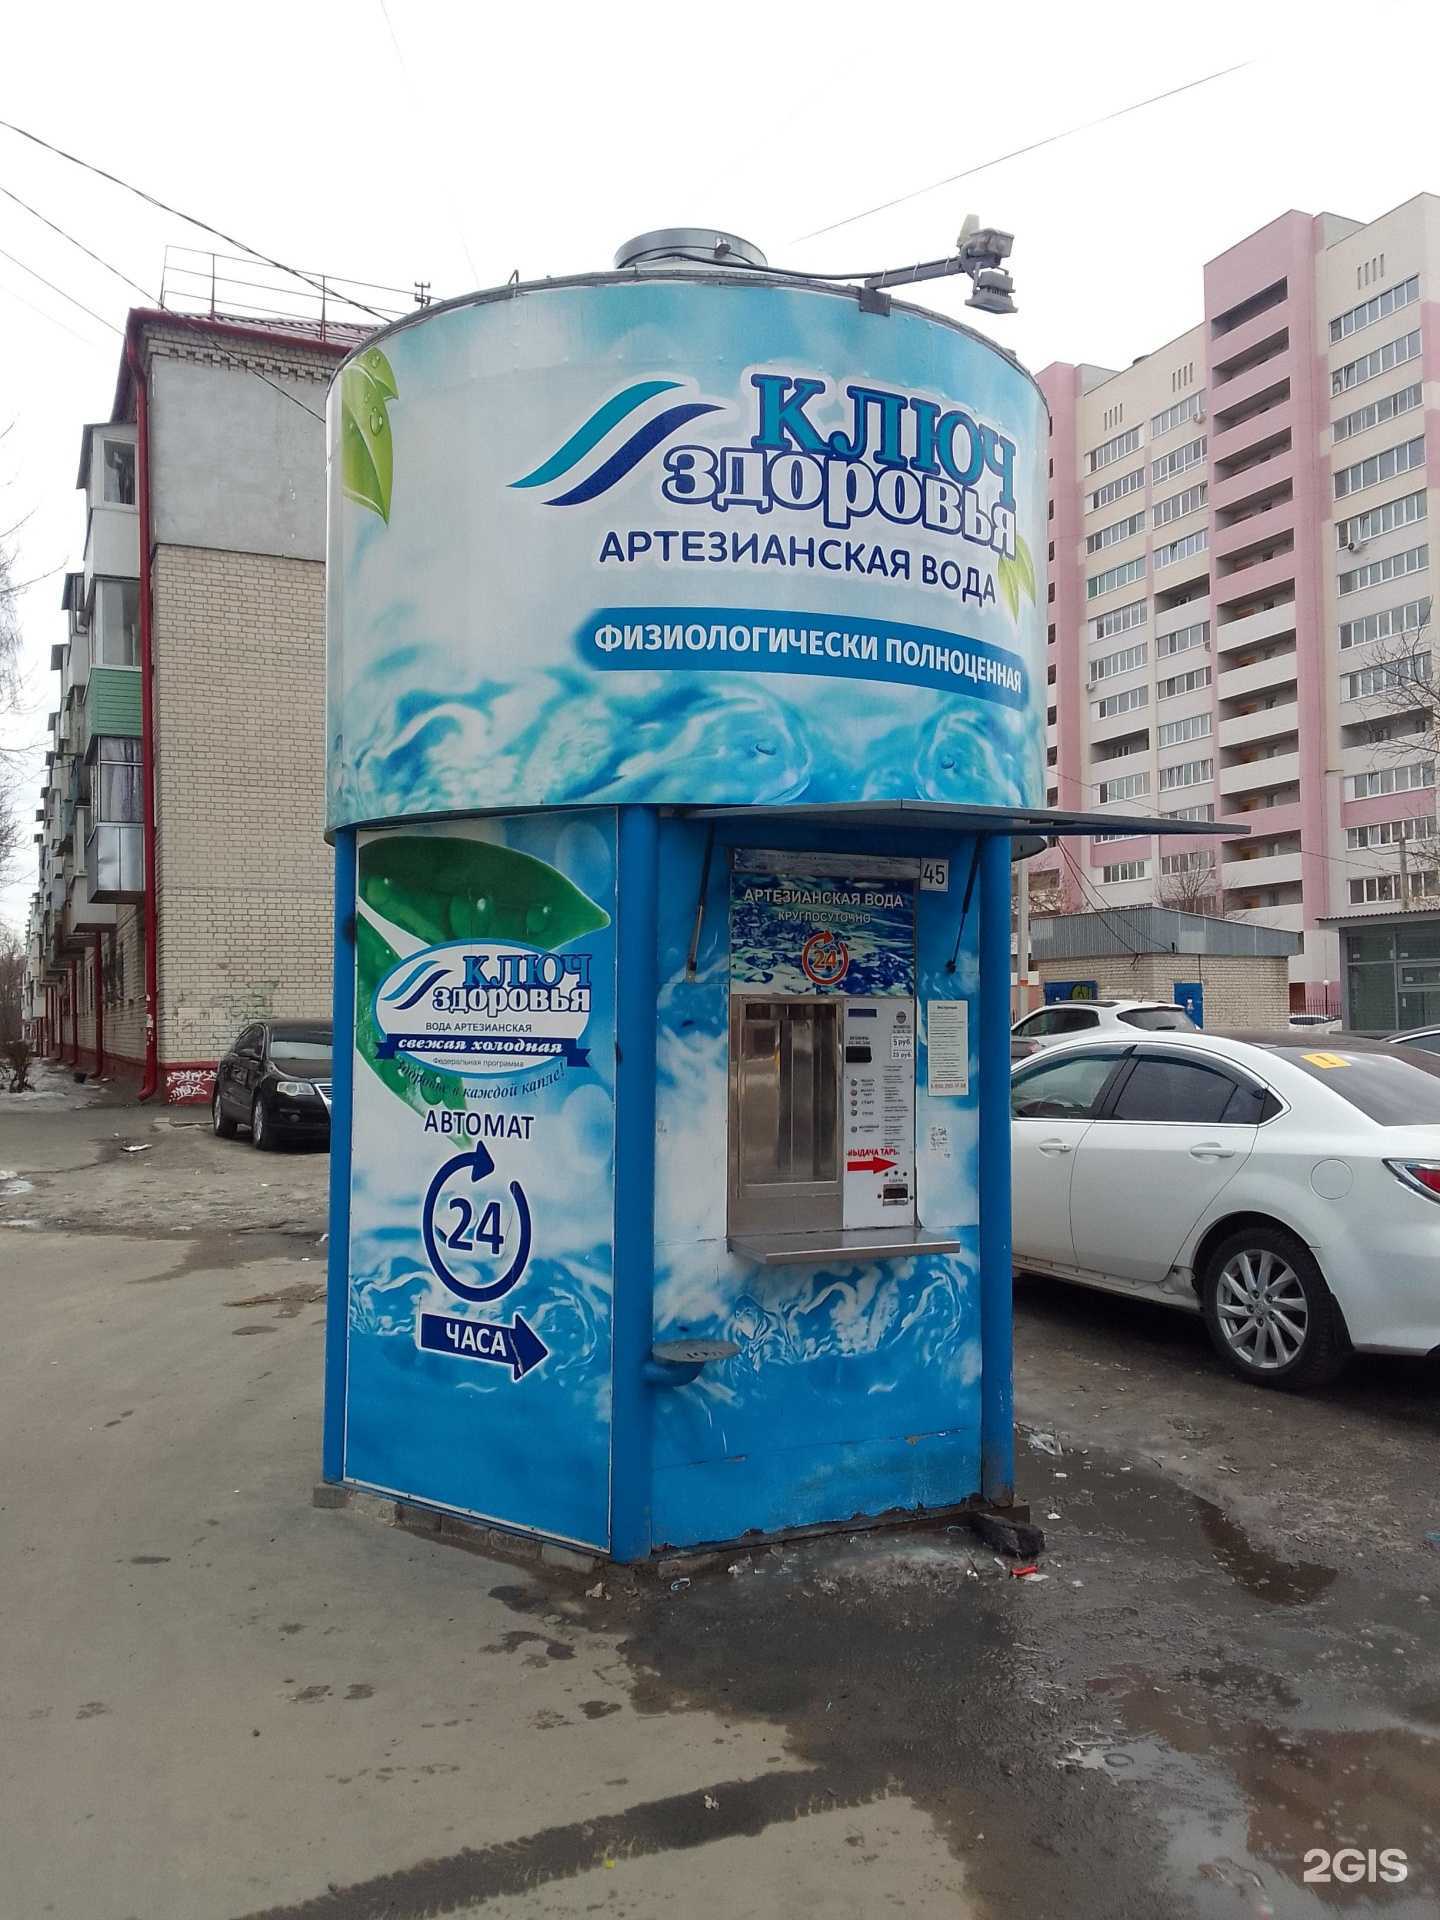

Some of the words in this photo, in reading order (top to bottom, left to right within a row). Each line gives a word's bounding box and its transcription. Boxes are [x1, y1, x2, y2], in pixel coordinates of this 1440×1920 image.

[751, 373, 1017, 511] КЛЮЧ
[600, 530, 910, 580] АРТЕЗИАНСКАЯ
[922, 557, 996, 607] ВОДА
[595, 623, 879, 661] ФИЗИОЛОГИЧЕСКИ
[886, 638, 1022, 693] ПОЛНОЦЕННАЯ
[924, 864, 945, 885] 45
[744, 889, 861, 905] АРТЕЗИАНСКАЯ
[865, 893, 903, 908] ВОДА
[778, 911, 871, 924] КРУГЛОСУТОЧНО
[463, 954, 592, 988] КЛЮЧ
[813, 951, 837, 969] 24
[425, 1022, 451, 1031] ВОДА
[454, 1023, 532, 1032] АРТЕЗИАНСКАЯ
[398, 1038, 466, 1050] свежая
[470, 1038, 563, 1053] холодная
[432, 1057, 482, 1066] Федеральная
[483, 1059, 524, 1067] программа
[463, 1082, 518, 1099] каждой
[522, 1061, 565, 1095] капле!
[423, 1109, 534, 1139] АВТОМАТ
[447, 1198, 505, 1256] 24
[445, 1322, 507, 1357] ЧАСА
